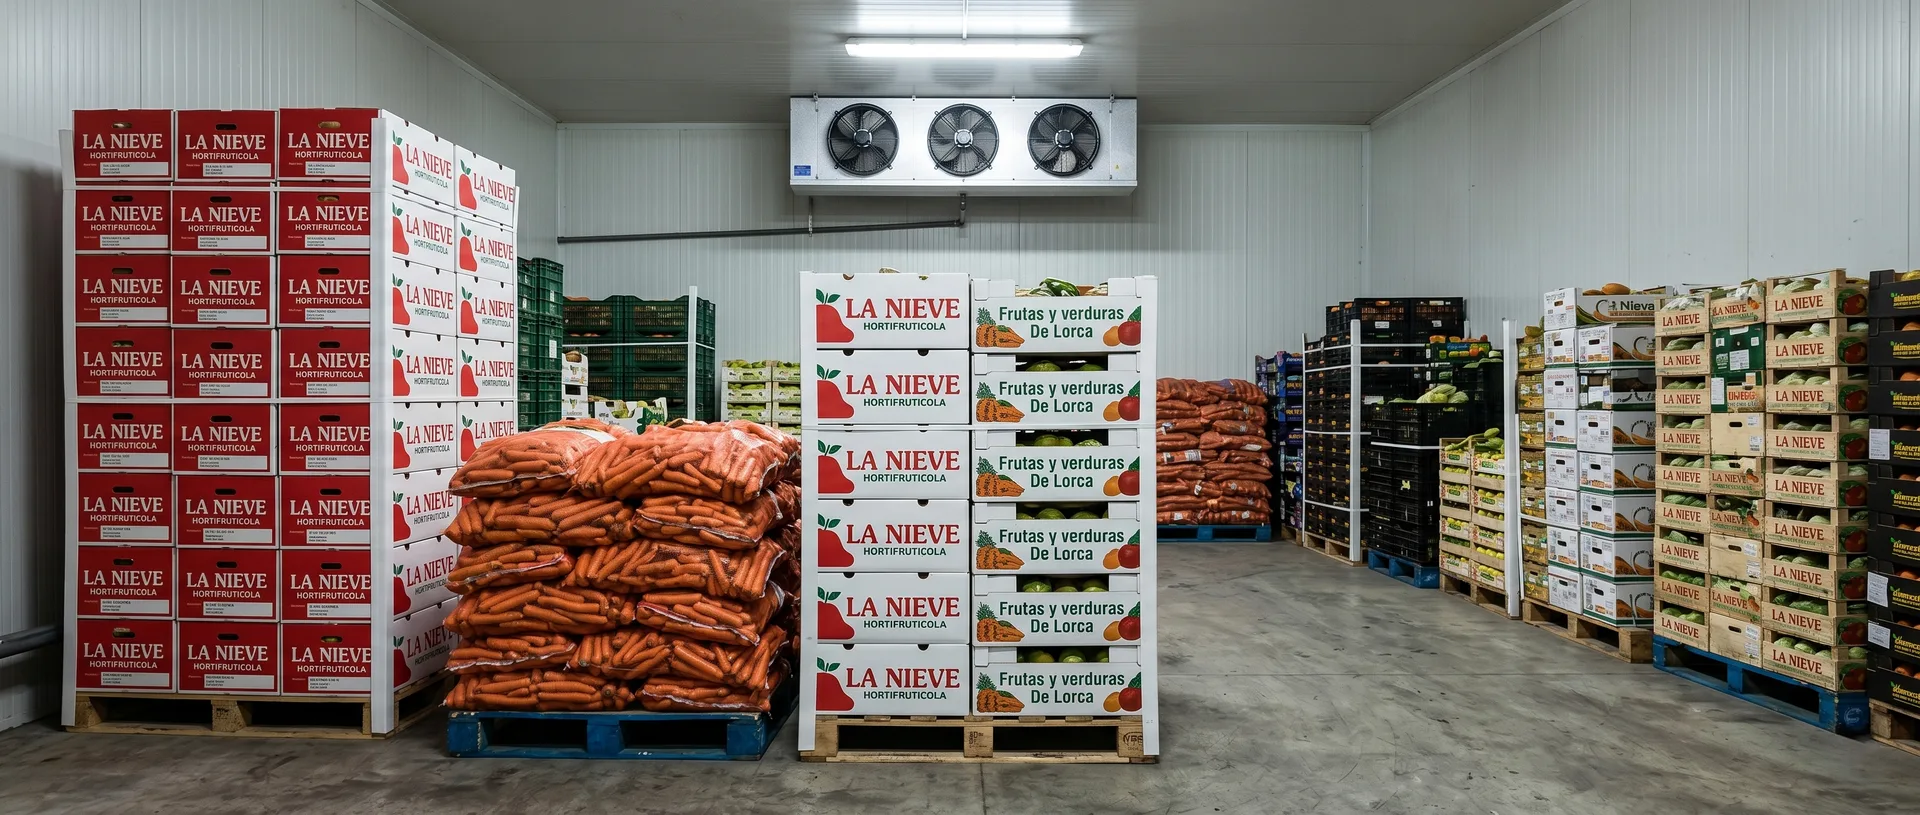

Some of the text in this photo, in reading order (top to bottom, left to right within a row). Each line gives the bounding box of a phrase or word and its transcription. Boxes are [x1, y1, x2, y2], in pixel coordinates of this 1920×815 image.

[82, 133, 163, 149] LA NIEVE
[185, 135, 266, 150] LA NIEVE
[288, 132, 369, 149] LA NIEVE
[91, 152, 156, 160] HORTIFRUTICOLA
[191, 152, 259, 160] HORTIFRUTICOLA
[295, 150, 362, 159] HORTIFRUTICOLA
[406, 144, 452, 179] LA NIEVE
[473, 173, 514, 202] LA NIEVE
[83, 206, 163, 222] LA NIEVE
[180, 206, 261, 223] LA NIEVE
[288, 206, 369, 222] LA NIEVE
[406, 215, 452, 245] LA NIEVE
[83, 278, 163, 295] LA NIEVE
[180, 279, 261, 295] LA NIEVE
[288, 278, 370, 295] LA NIEVE
[91, 296, 156, 304] HORTIFRUTICOLA
[188, 297, 255, 306] HORTIFRUTICOLA
[296, 296, 362, 306] HORTIFRUTICOLA
[406, 284, 453, 309] LA NIEVE
[1775, 295, 1823, 311] LA NIEVE
[475, 297, 514, 318] LA NIEVE
[847, 298, 959, 318] LA NIEVE
[1621, 301, 1655, 310] Nieva
[1000, 306, 1124, 323] Frutas y verduras
[1663, 316, 1673, 327] LA
[1676, 314, 1700, 325] NIEVE
[1031, 325, 1092, 338] De Lorca
[1776, 343, 1824, 356] LA NIEVE
[83, 352, 163, 368] LA NIEVE
[181, 353, 262, 369] LA NIEVE
[289, 352, 370, 369] LA NIEVE
[407, 356, 453, 375] LA NIEVE
[1663, 355, 1700, 365] LA NIEVE
[847, 375, 960, 395] LA NIEVE
[1000, 381, 1124, 400] Frutas y verduras
[1664, 394, 1701, 404] LA NIEVE
[1776, 391, 1824, 402] LA NIEVE
[1031, 399, 1092, 412] De Lorca
[407, 424, 453, 444] LA NIEVE
[1663, 433, 1701, 443] LA NIEVE
[1776, 436, 1825, 449] LA NIEVE
[847, 451, 959, 470] LA NIEVE
[1000, 456, 1124, 473] Frutas y verduras
[864, 474, 946, 482] HORTIFRUTICOLA
[1031, 474, 1093, 487] De Lorca
[1663, 470, 1701, 483] LA NIEVE
[1775, 479, 1824, 495] LA NIEVE
[84, 496, 163, 512] LA NIEVE
[186, 499, 266, 515] LA NIEVE
[290, 499, 370, 515] LA NIEVE
[91, 514, 157, 522] HORTIFRUTICOLA
[192, 517, 260, 526] HORTIFRUTICOLA
[297, 517, 365, 526] HORTIFRUTICOLA
[1663, 508, 1701, 522] LA NIEVE
[848, 524, 959, 544] LA NIEVE
[1000, 529, 1124, 545] Frutas y verduras
[1775, 523, 1824, 540] LA NIEVE
[1031, 547, 1093, 560] De Lorca
[1661, 543, 1699, 560] LA NIEVE
[1773, 565, 1822, 585] LA NIEVE
[1661, 581, 1699, 600] LA NIEVE
[848, 597, 959, 617] LA NIEVE
[1712, 592, 1747, 609] LA NIEVE
[1000, 601, 1124, 618] Frutas y verduras
[1031, 619, 1093, 633] De Lorca
[1661, 617, 1699, 638] LA NIEVE
[1773, 609, 1821, 631] LA NIEVE
[84, 642, 164, 658] LA NIEVE
[188, 645, 268, 661] LA NIEVE
[291, 646, 372, 663] LA NIEVE
[90, 660, 157, 669] HORTIFRUTICOLA
[194, 663, 262, 671] HORTIFRUTICOLA
[297, 665, 366, 674] HORTIFRUTICOLA
[1773, 650, 1822, 674] LA NIEVE
[847, 668, 959, 688] LA NIEVE
[1000, 672, 1124, 689] Frutas y verduras
[864, 691, 946, 699] HORTIFRUTICOLA
[1031, 690, 1093, 703] De Lorca
